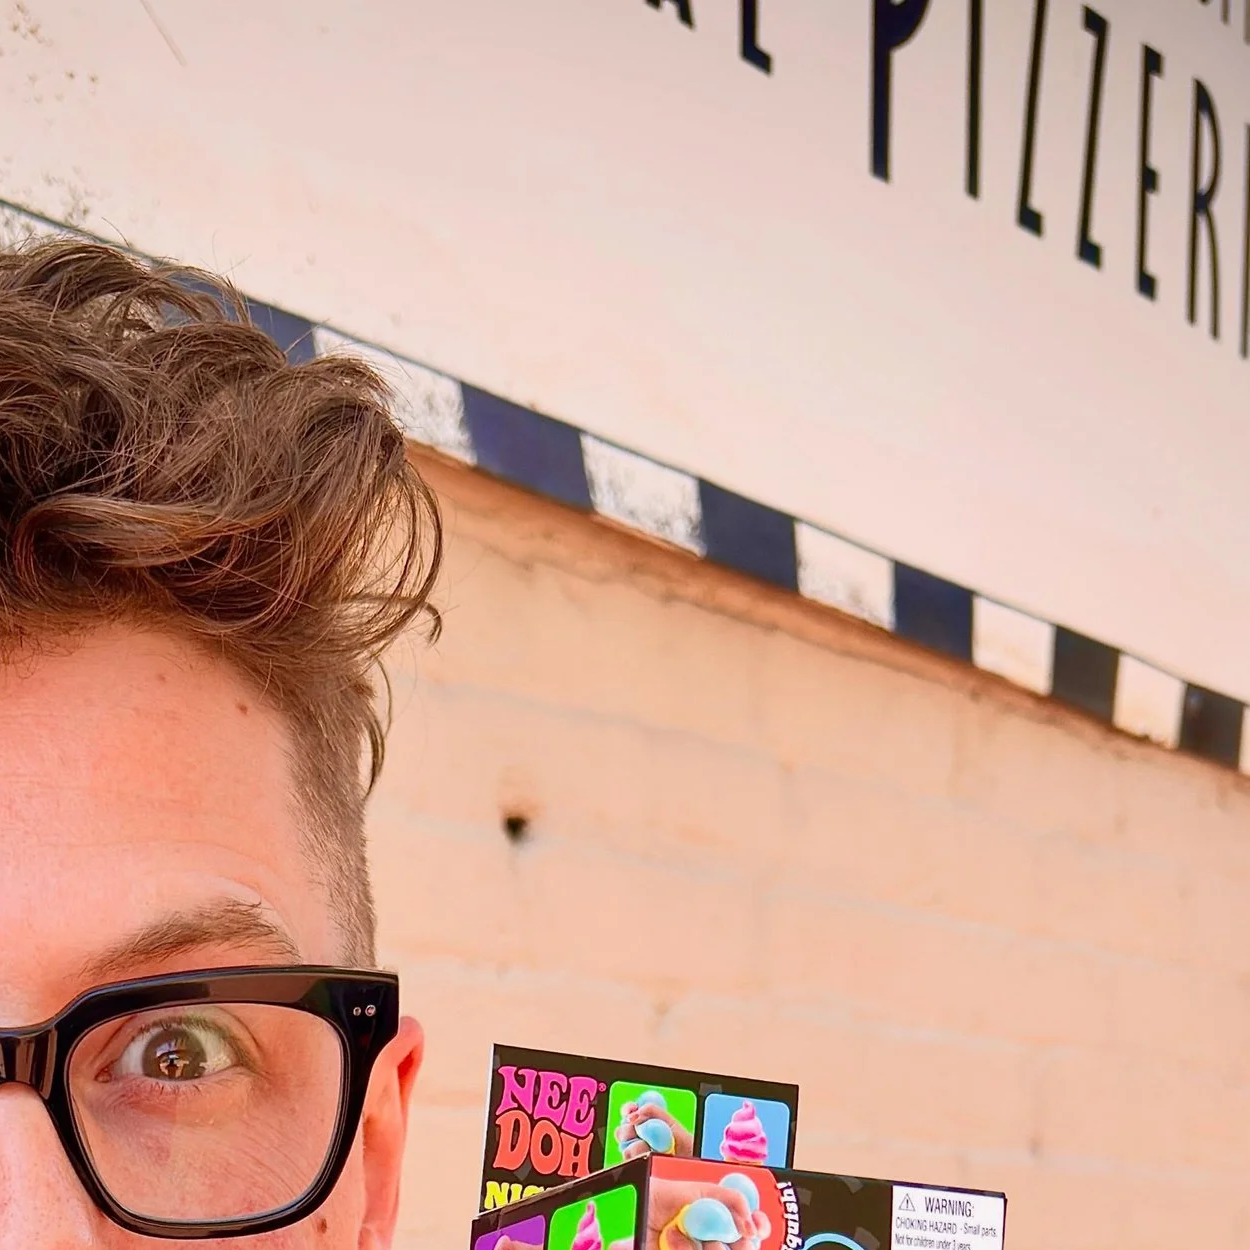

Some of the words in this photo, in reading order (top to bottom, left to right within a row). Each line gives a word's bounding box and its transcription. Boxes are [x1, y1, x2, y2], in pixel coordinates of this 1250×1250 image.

[496, 1065, 598, 1138] NEE
[493, 1109, 594, 1178] DOH
[925, 1196, 975, 1218] WARNING:
[895, 1216, 928, 1232] CHOKING
[929, 1221, 957, 1235] HAZARD
[963, 1222, 980, 1236] Small
[895, 1233, 905, 1245] Not
[905, 1234, 913, 1245] for
[913, 1235, 935, 1248] children
[936, 1238, 952, 1250] under
